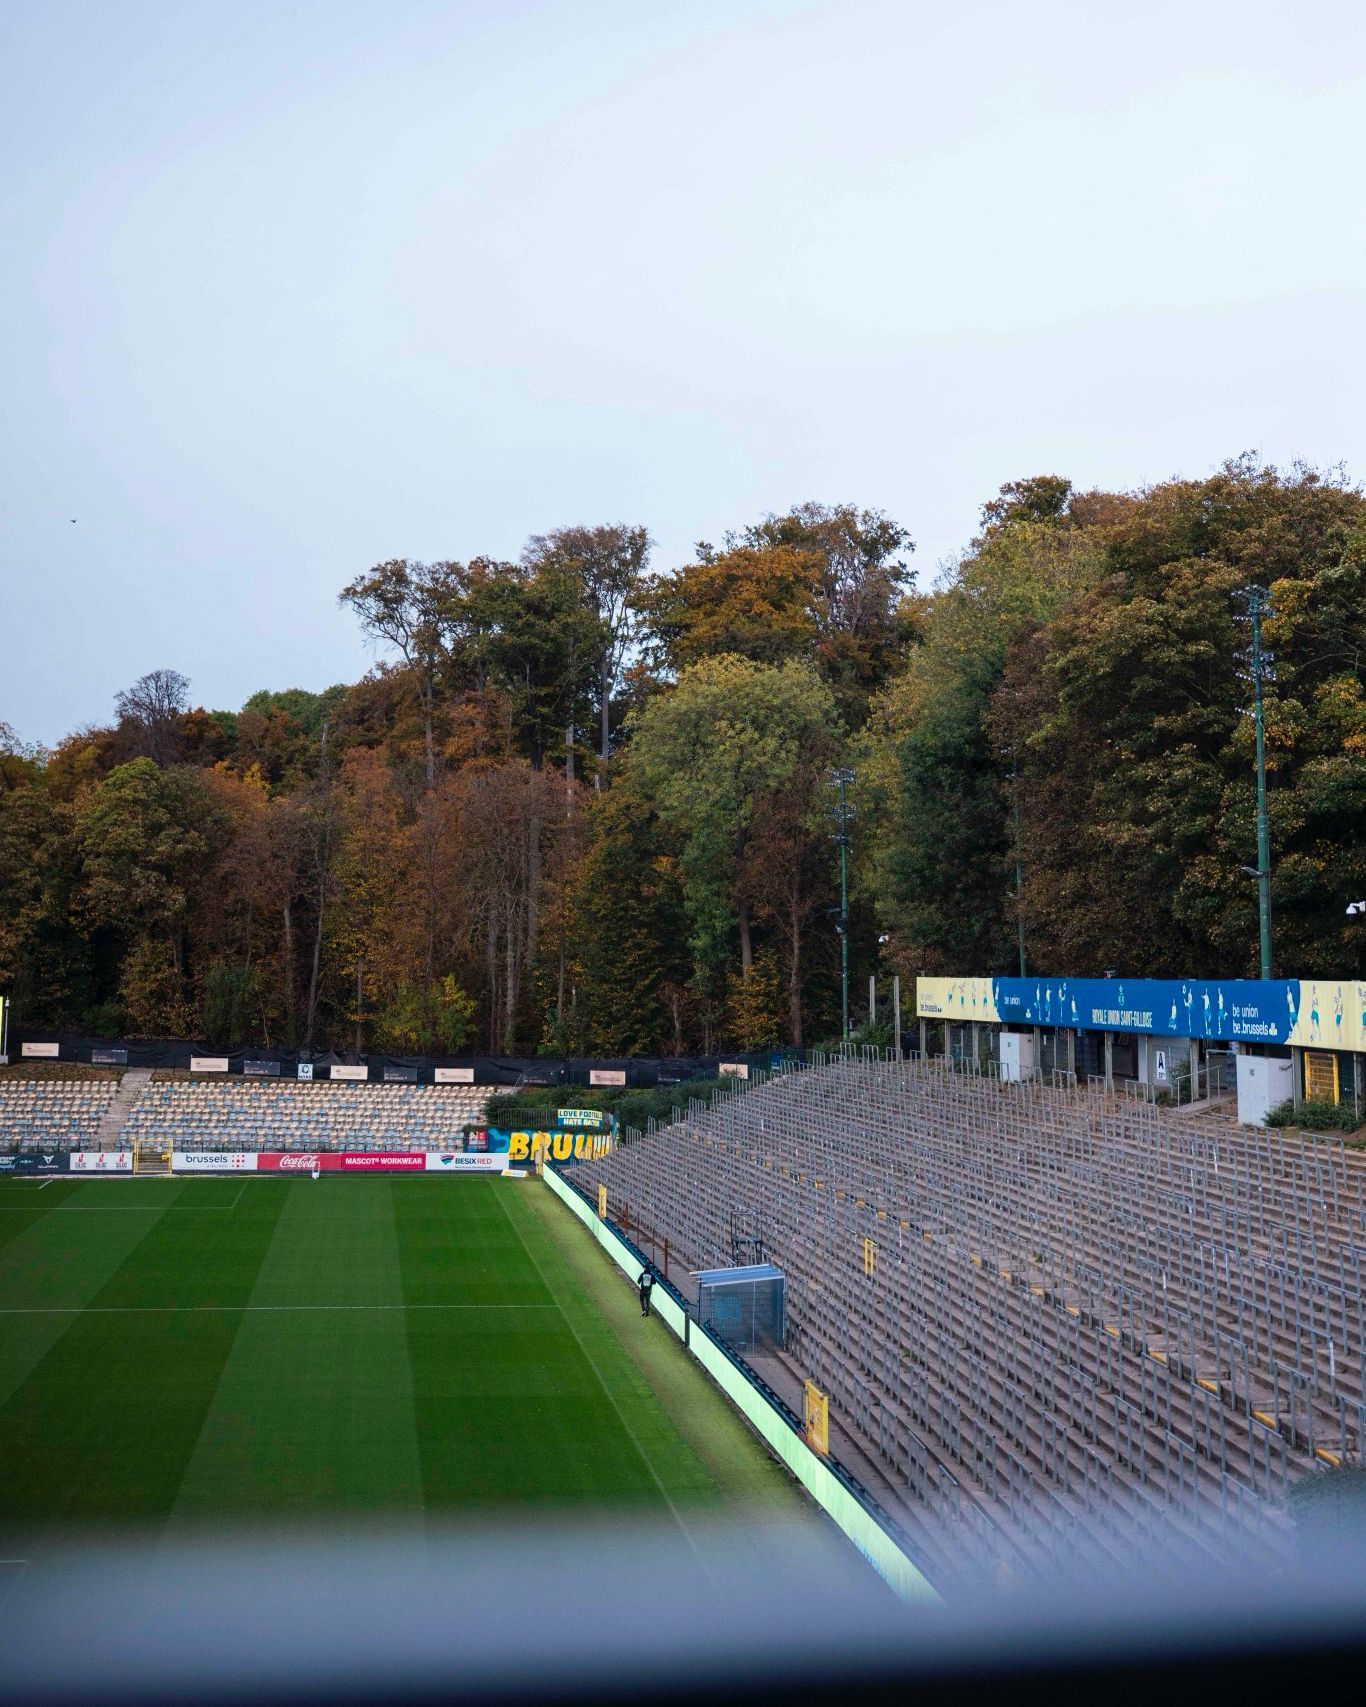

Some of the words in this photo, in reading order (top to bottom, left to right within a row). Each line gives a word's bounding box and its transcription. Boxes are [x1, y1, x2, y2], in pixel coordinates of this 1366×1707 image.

[1232, 1004, 1240, 1018] be
[1242, 1003, 1259, 1018] union
[1092, 1009, 1107, 1024] ROYALE
[1107, 1009, 1120, 1025] UNION
[1158, 1052, 1164, 1069] A
[186, 1155, 228, 1163] brussels
[381, 1157, 423, 1165] WORKWEAR
[455, 1157, 476, 1165] BESIX
